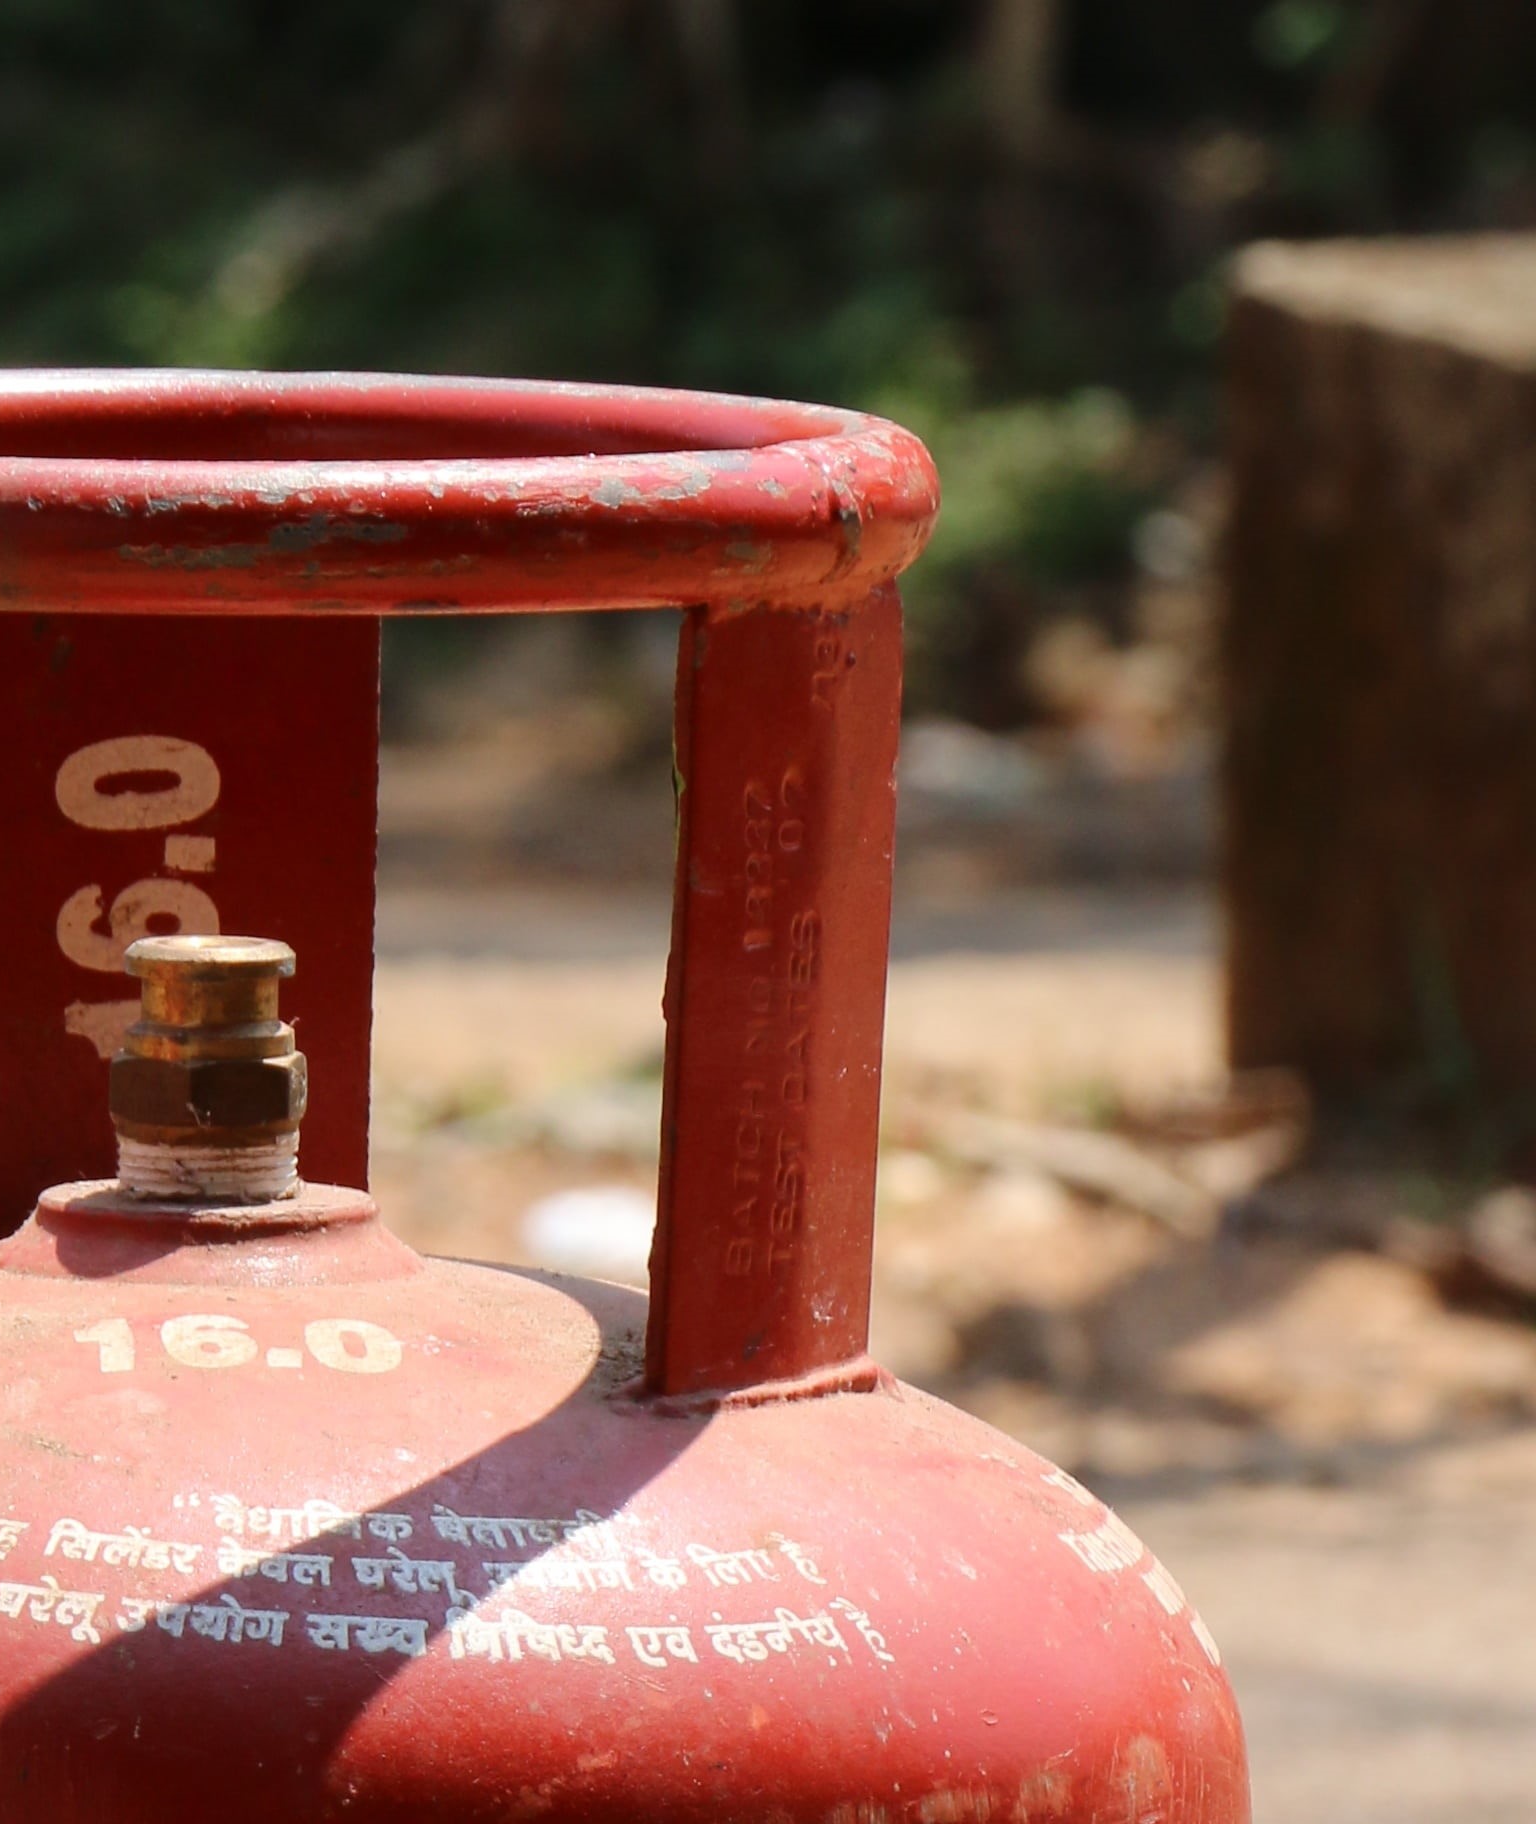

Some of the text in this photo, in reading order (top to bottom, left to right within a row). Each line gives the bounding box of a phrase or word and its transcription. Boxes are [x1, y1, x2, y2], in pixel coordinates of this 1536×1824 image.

[55, 734, 221, 1060] 16.0
[768, 1129, 800, 1275] TEST
[73, 1313, 403, 1374] 16.0
[217, 1535, 334, 1586] केवल
[116, 1594, 290, 1647] उपयोग
[625, 1613, 699, 1669] एवं
